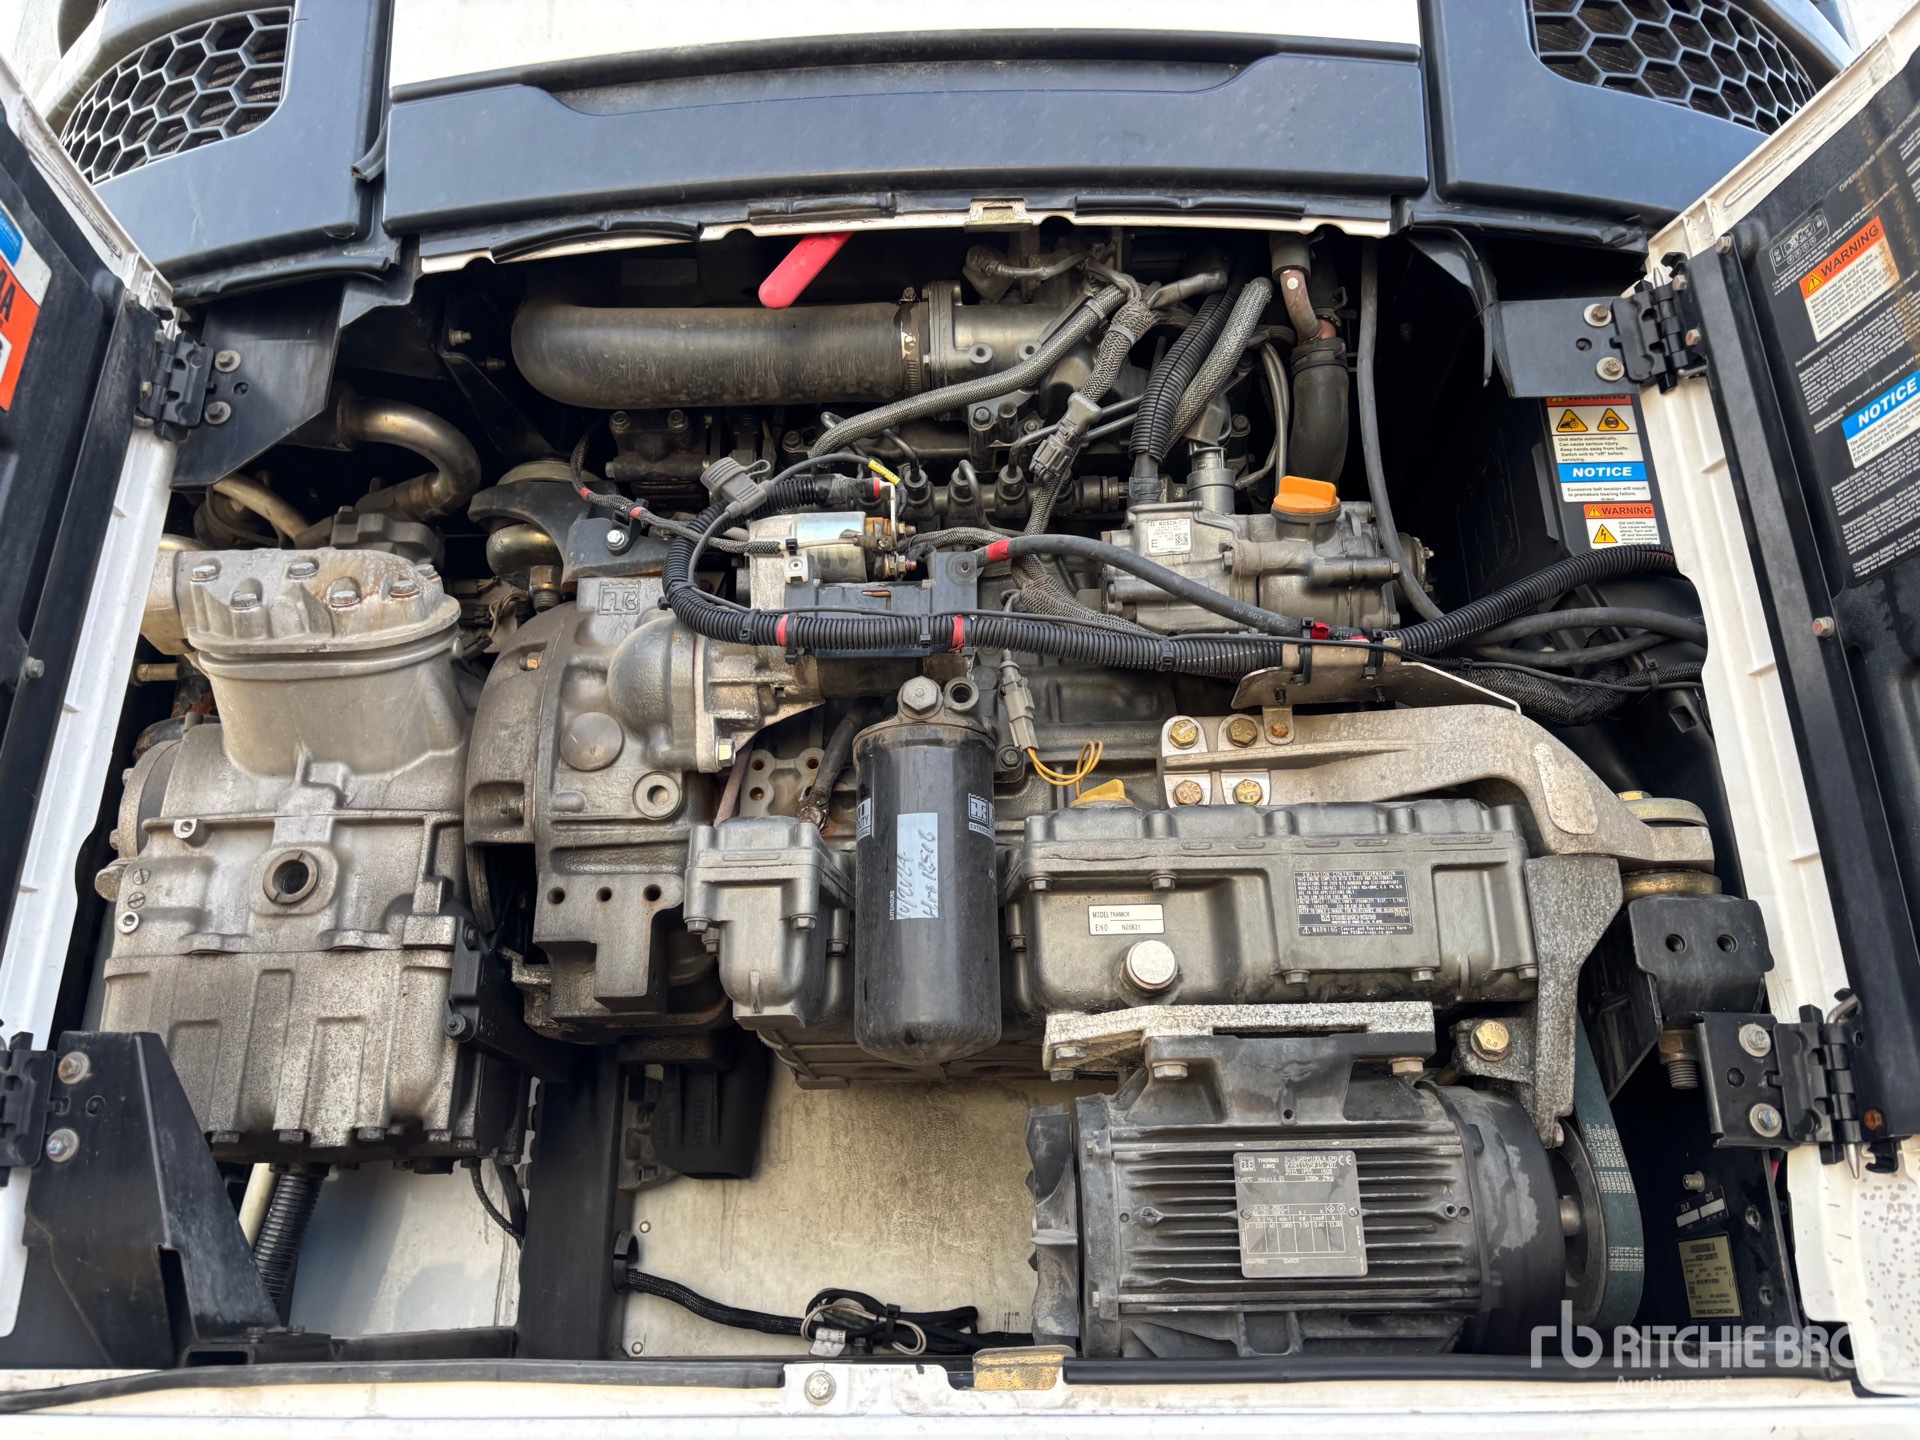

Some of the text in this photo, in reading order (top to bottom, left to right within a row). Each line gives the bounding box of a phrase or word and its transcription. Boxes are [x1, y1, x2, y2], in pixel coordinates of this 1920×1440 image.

[1820, 223, 1879, 278] WARNING
[1856, 376, 1918, 428] NOTICE
[1571, 466, 1633, 477] NOTICE
[1601, 506, 1651, 515] WARNING
